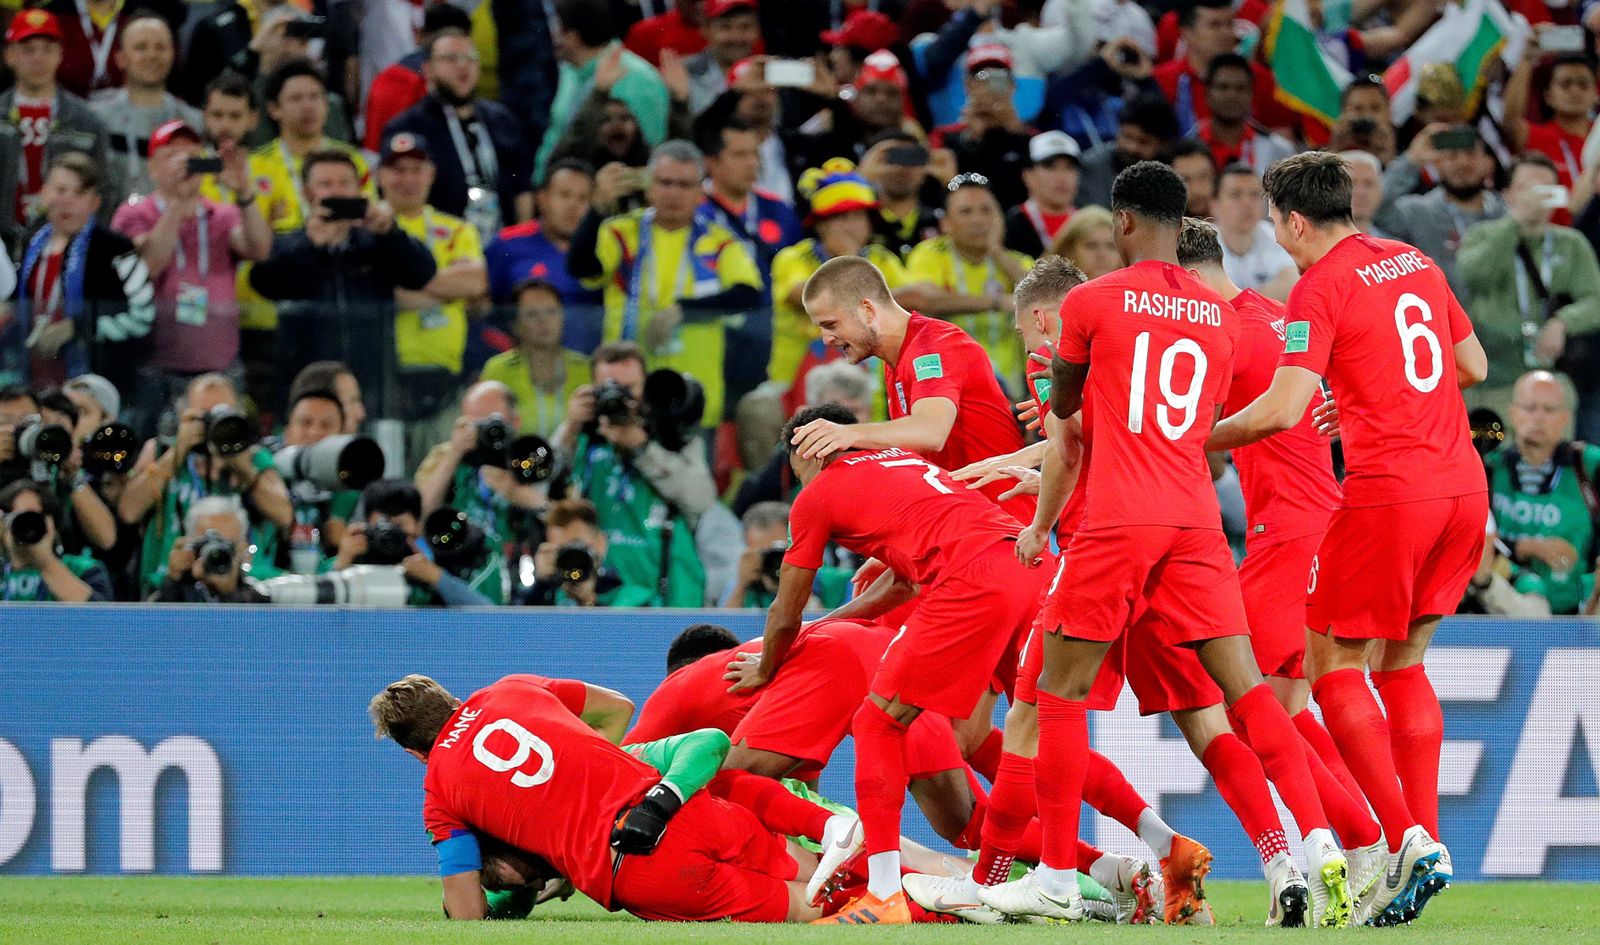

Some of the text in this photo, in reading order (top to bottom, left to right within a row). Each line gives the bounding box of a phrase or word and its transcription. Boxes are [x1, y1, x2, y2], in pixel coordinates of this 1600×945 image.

[1355, 251, 1430, 287] MAGUIRE
[1123, 290, 1222, 327] RASHFORD
[1394, 292, 1443, 393] 6
[1128, 331, 1208, 441] 19
[878, 458, 955, 495] 7
[1306, 554, 1320, 595] 6
[438, 706, 483, 750] KANE
[472, 718, 555, 788] 9
[1092, 648, 1600, 874] FFA
